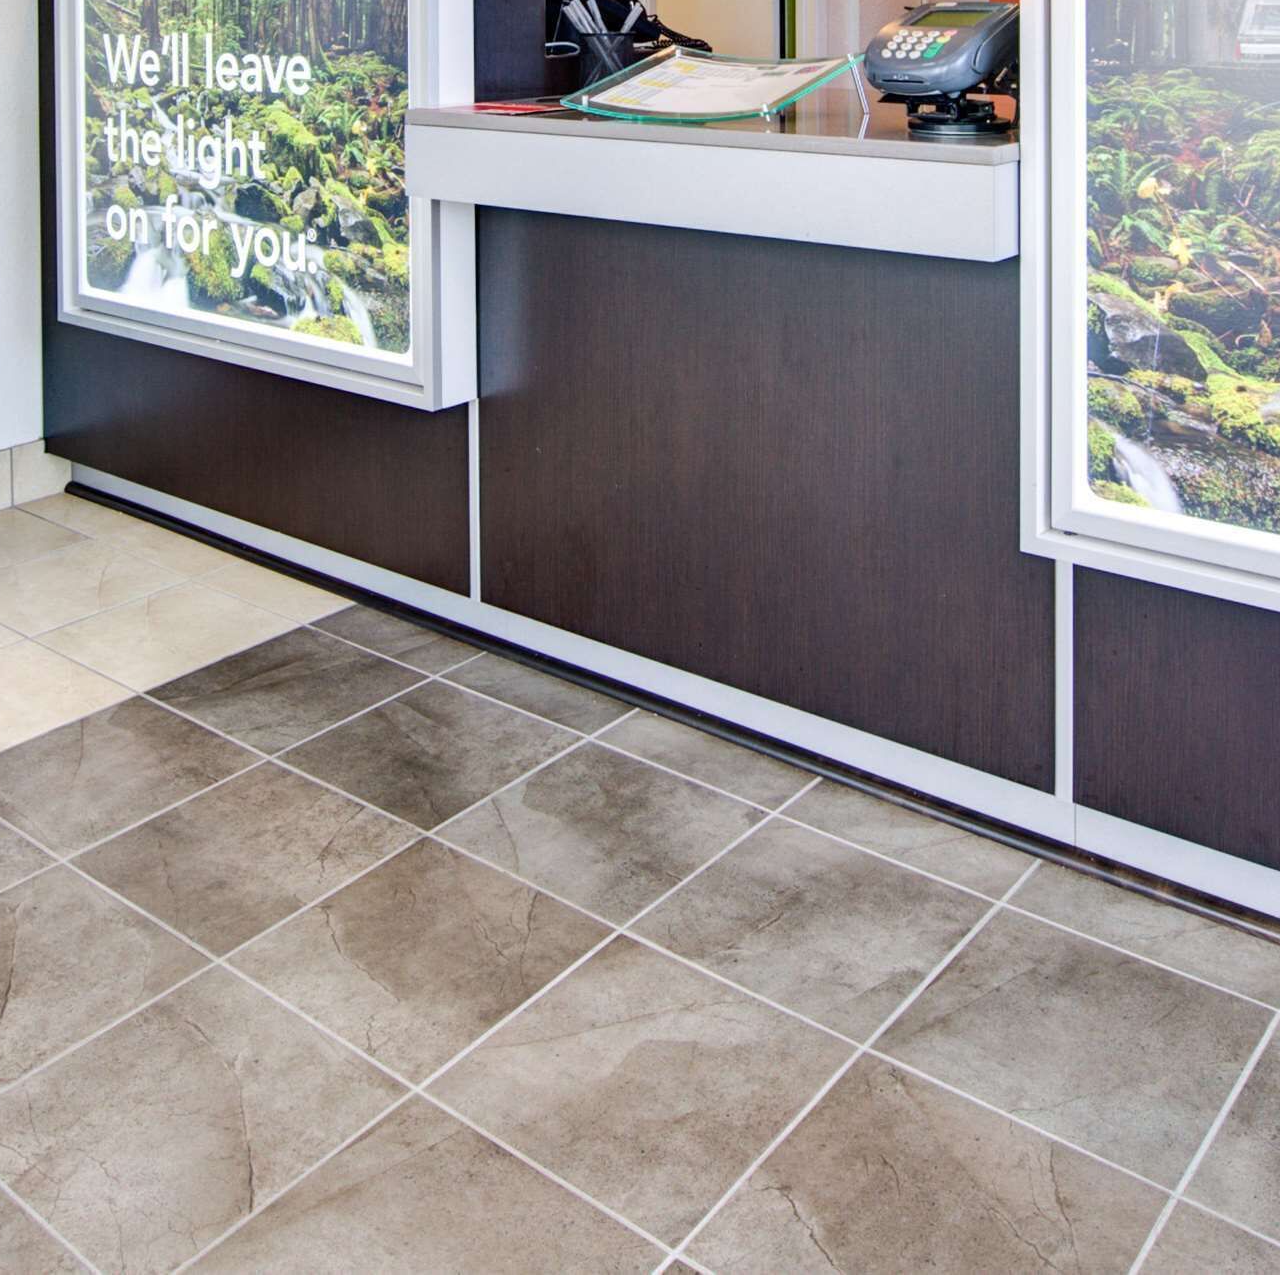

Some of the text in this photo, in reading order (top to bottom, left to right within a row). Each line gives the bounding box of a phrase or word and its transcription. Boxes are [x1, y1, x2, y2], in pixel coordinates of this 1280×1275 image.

[103, 32, 313, 95] We'll leave
[104, 111, 266, 188] the light
[106, 203, 149, 244] on
[161, 195, 219, 256] for
